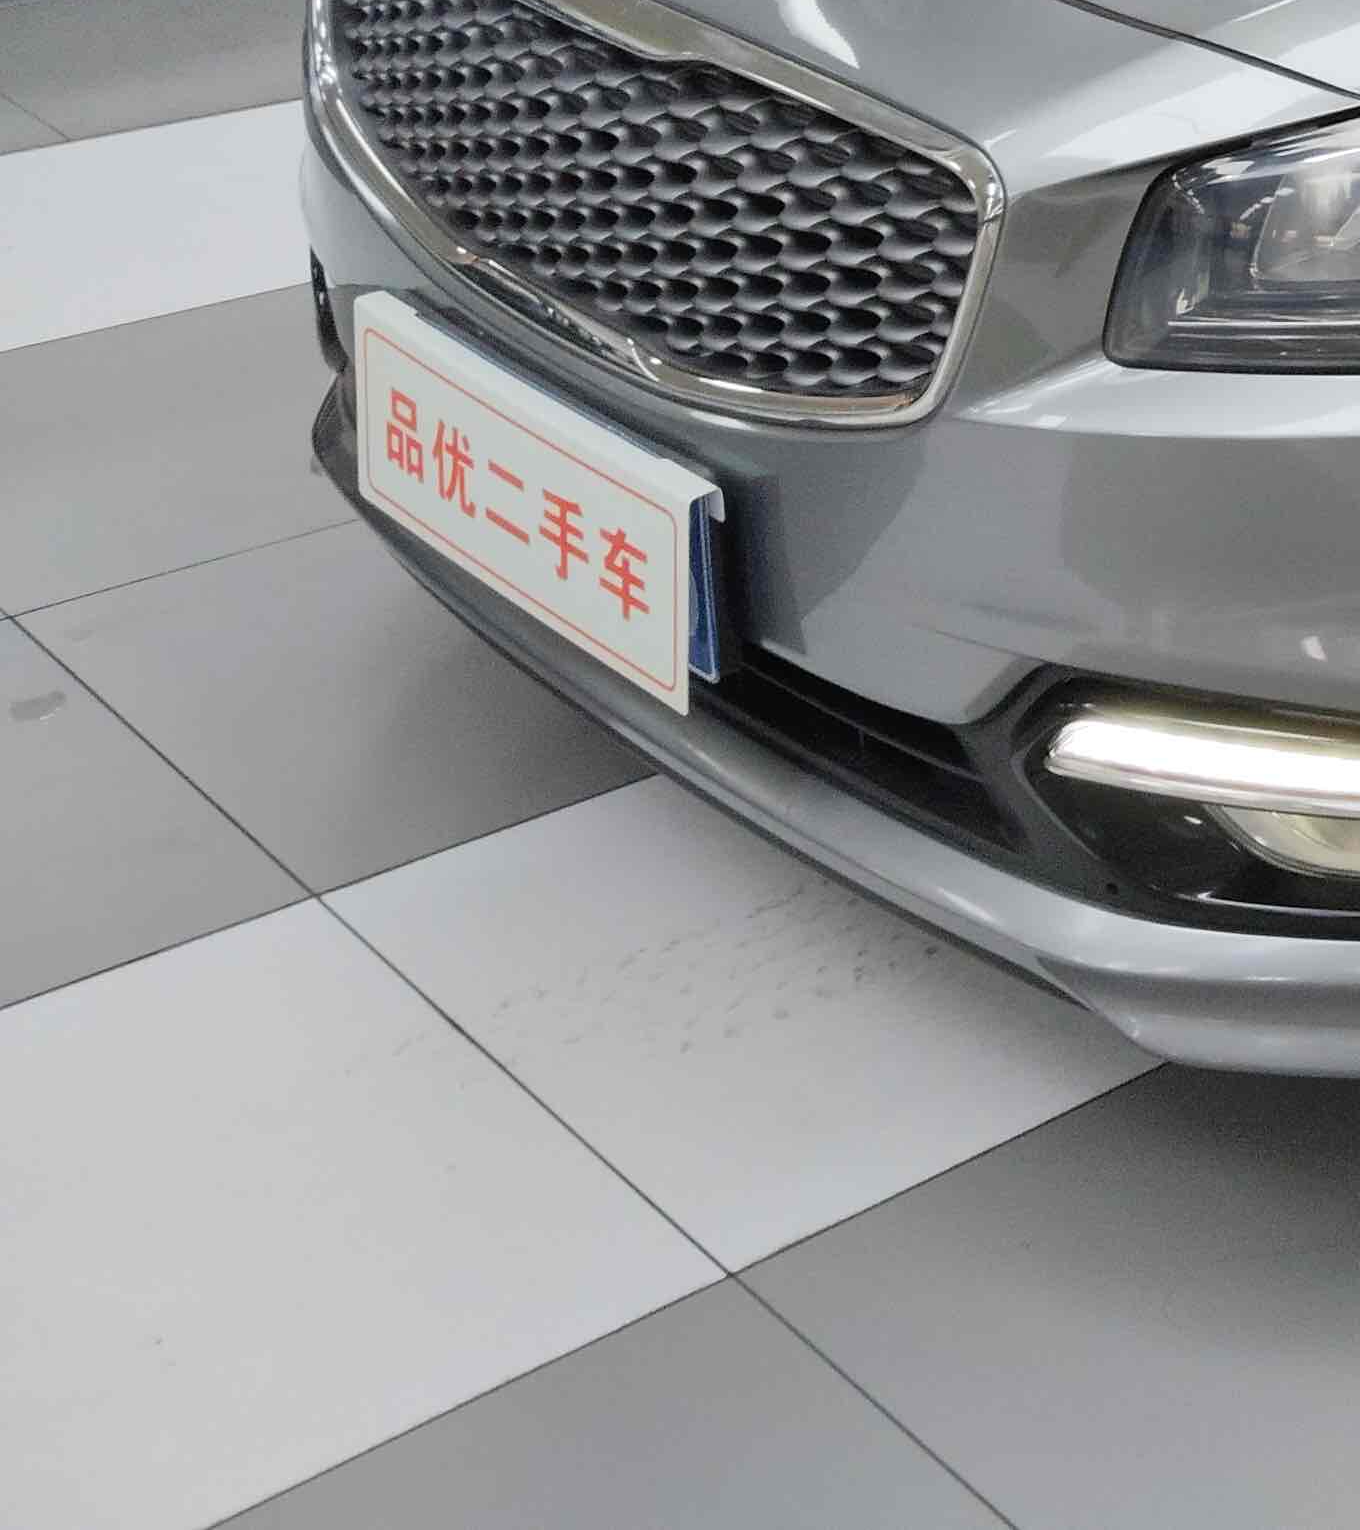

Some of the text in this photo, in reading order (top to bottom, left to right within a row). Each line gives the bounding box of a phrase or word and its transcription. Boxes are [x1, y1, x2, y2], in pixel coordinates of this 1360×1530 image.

[385, 386, 651, 621] 品优二手车
